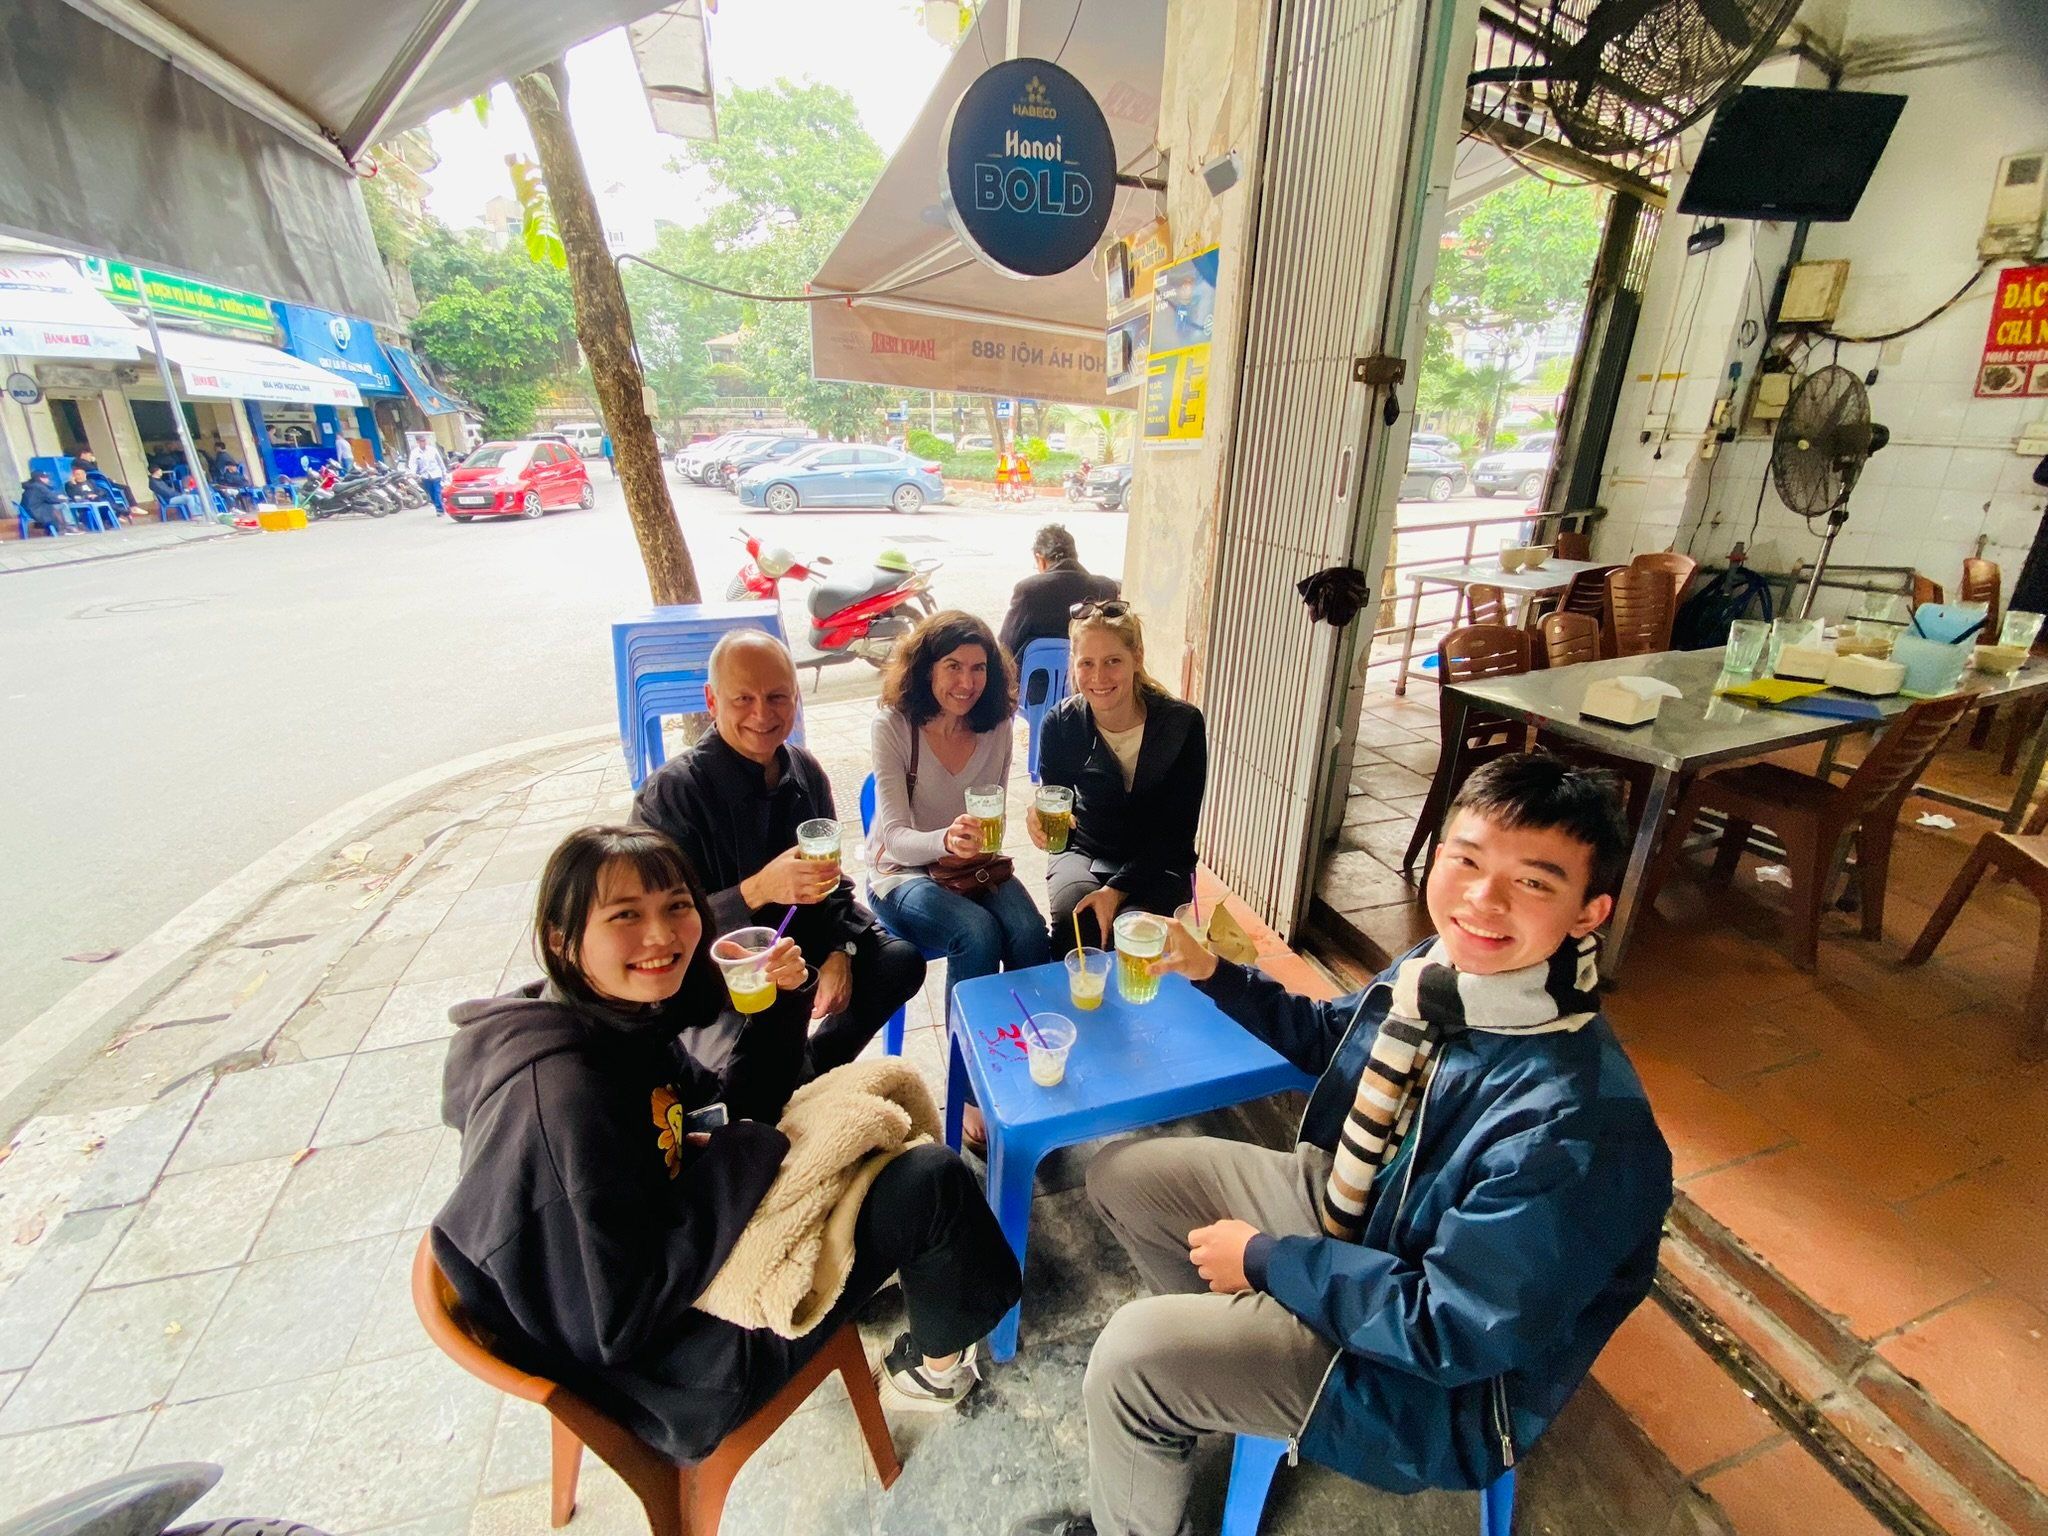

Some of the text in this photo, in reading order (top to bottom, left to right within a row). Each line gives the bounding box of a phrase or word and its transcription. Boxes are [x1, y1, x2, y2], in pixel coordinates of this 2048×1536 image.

[1013, 104, 1056, 119] HABECO
[1005, 130, 1062, 162] Hanoi
[975, 163, 1092, 217] BOLD
[2003, 276, 2048, 313] ĐẶC
[1996, 309, 2033, 345] CHẢ
